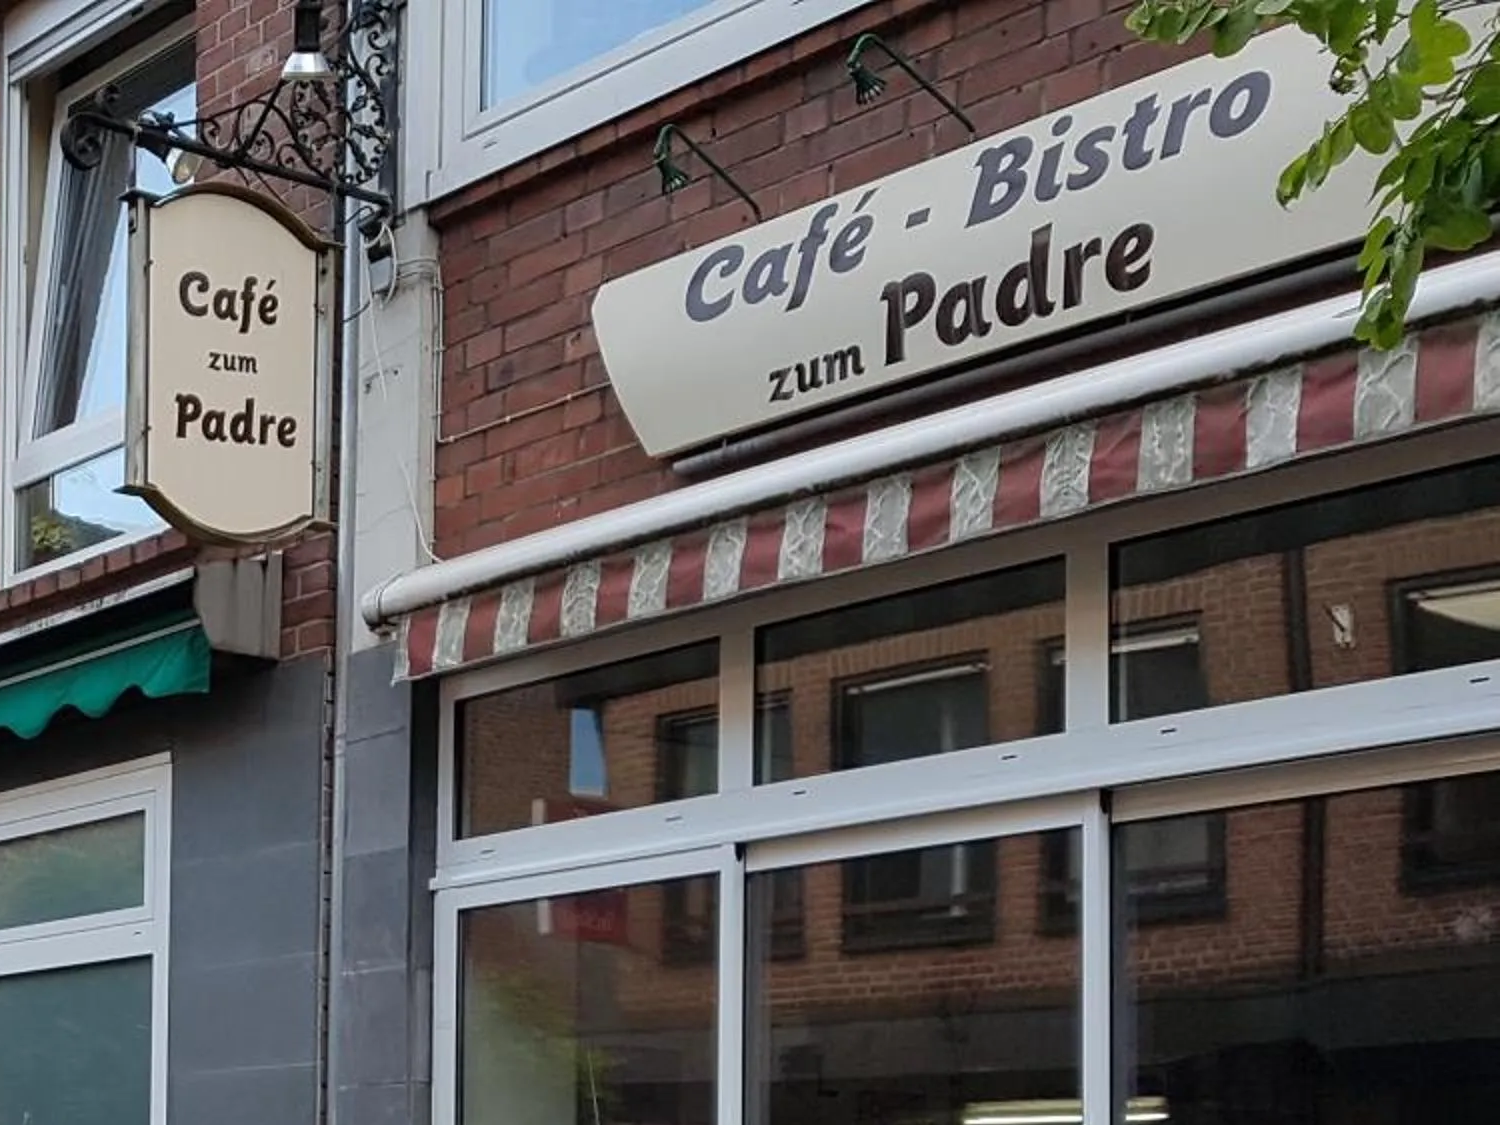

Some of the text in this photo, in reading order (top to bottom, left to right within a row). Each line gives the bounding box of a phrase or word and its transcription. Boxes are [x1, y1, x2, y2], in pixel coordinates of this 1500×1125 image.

[685, 70, 1272, 323] Café - Bistro
[179, 270, 280, 334] Café
[768, 223, 1154, 402] zum Padre
[208, 350, 258, 374] zum
[174, 393, 298, 448] Padre
